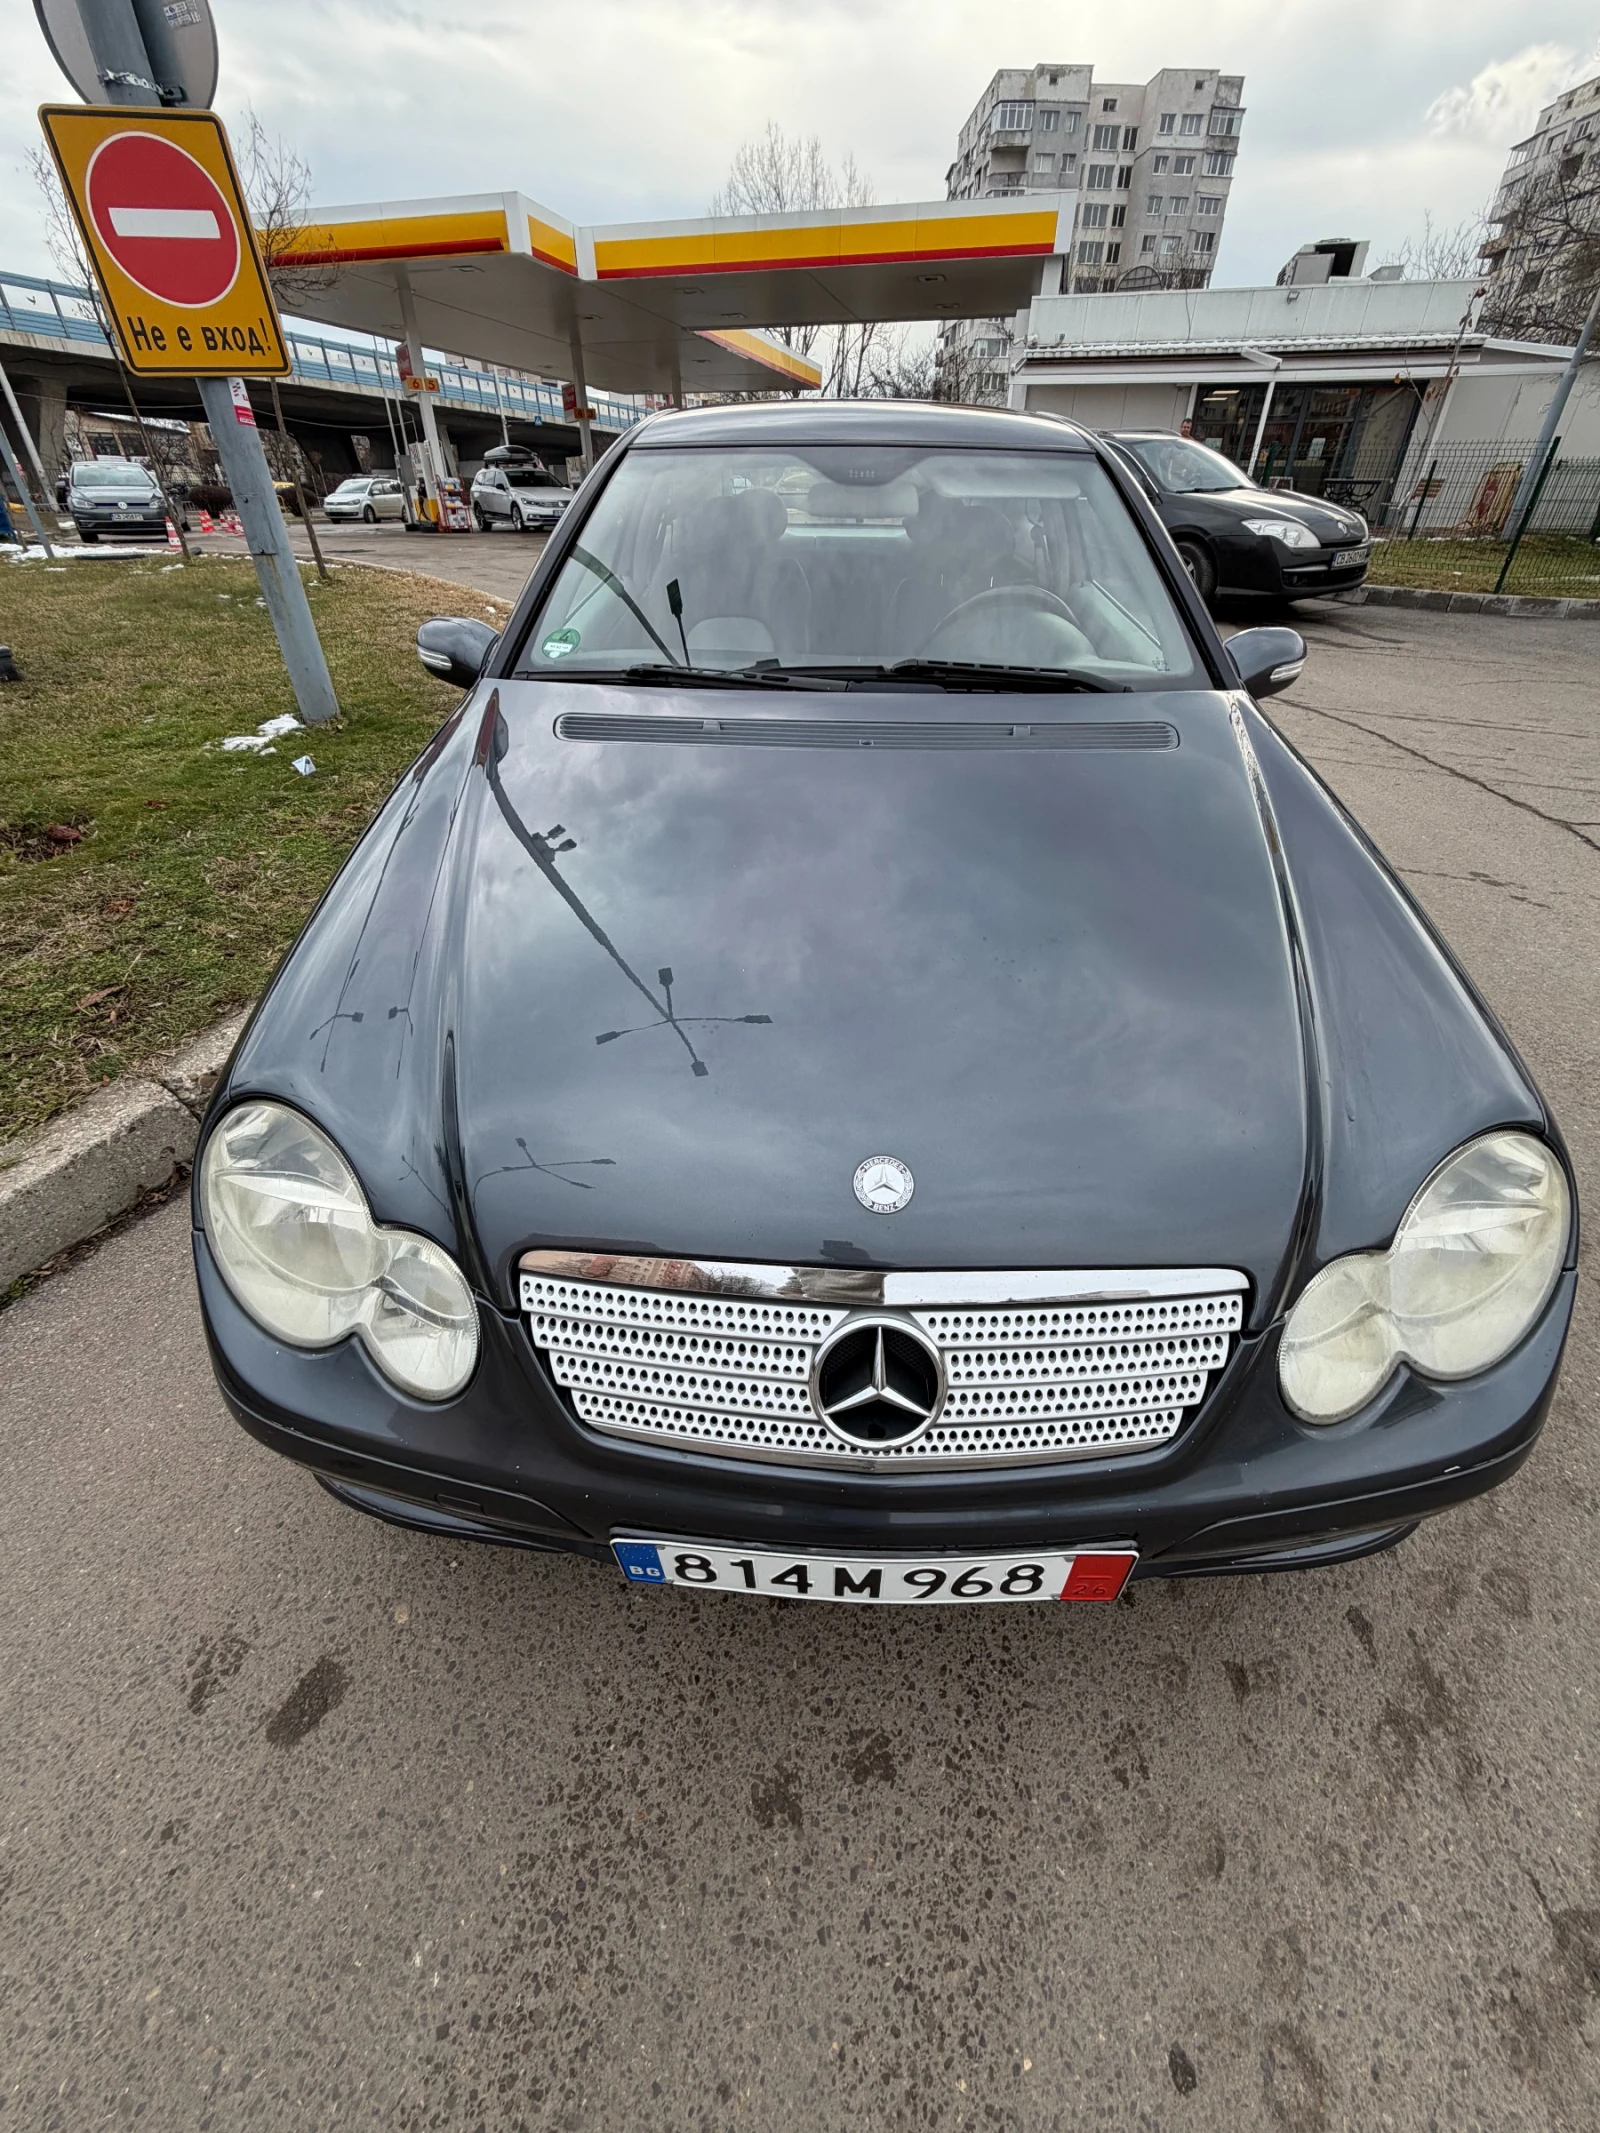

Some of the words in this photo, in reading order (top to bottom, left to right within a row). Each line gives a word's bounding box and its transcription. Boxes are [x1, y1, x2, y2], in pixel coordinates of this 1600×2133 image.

[127, 316, 167, 351] Не
[176, 325, 193, 351] е
[201, 317, 272, 356] вход!
[559, 629, 571, 643] 4
[863, 1157, 905, 1171] MERCEDES
[872, 1202, 897, 1211] BENZ
[629, 1565, 661, 1577] BG
[1072, 1582, 1107, 1596] 26
